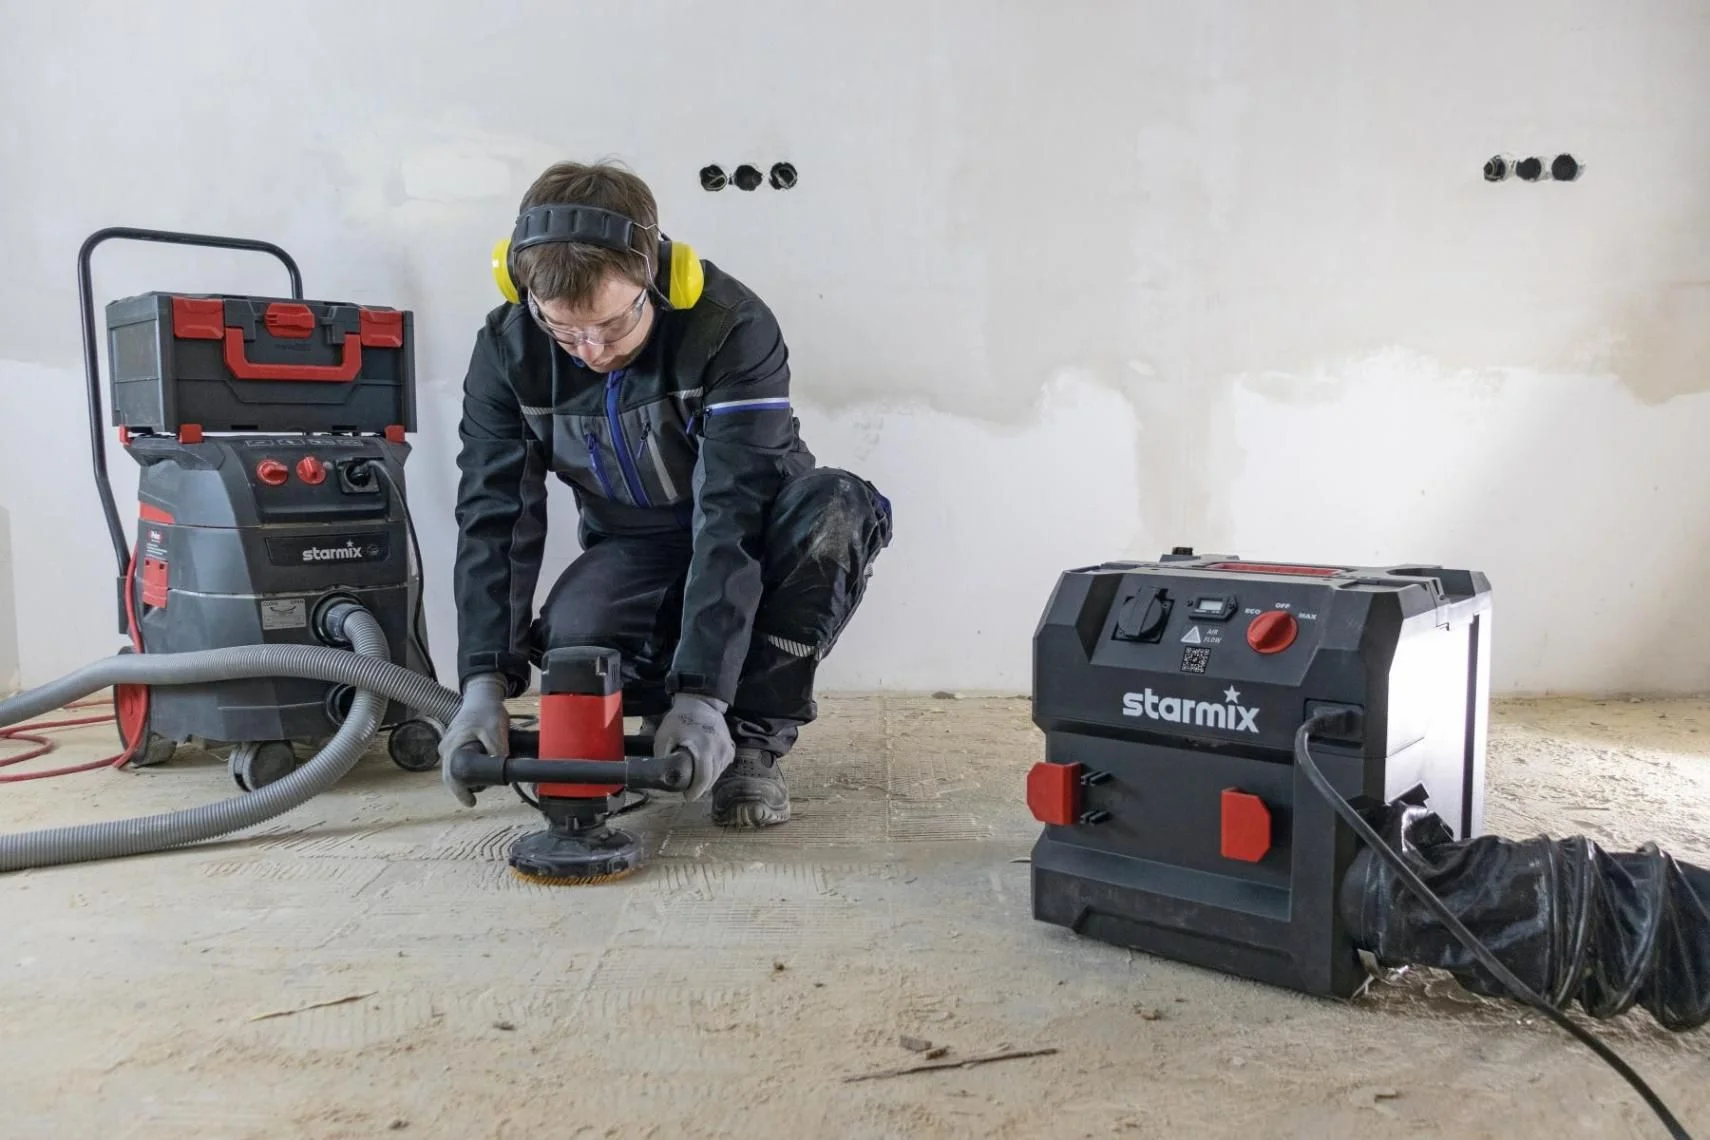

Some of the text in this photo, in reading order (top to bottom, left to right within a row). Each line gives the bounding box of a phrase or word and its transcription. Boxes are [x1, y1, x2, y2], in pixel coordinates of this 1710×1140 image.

[302, 540, 362, 561] starmix
[1298, 612, 1317, 620] MAX
[1203, 636, 1222, 644] FLOW
[1122, 684, 1260, 734] starmix
